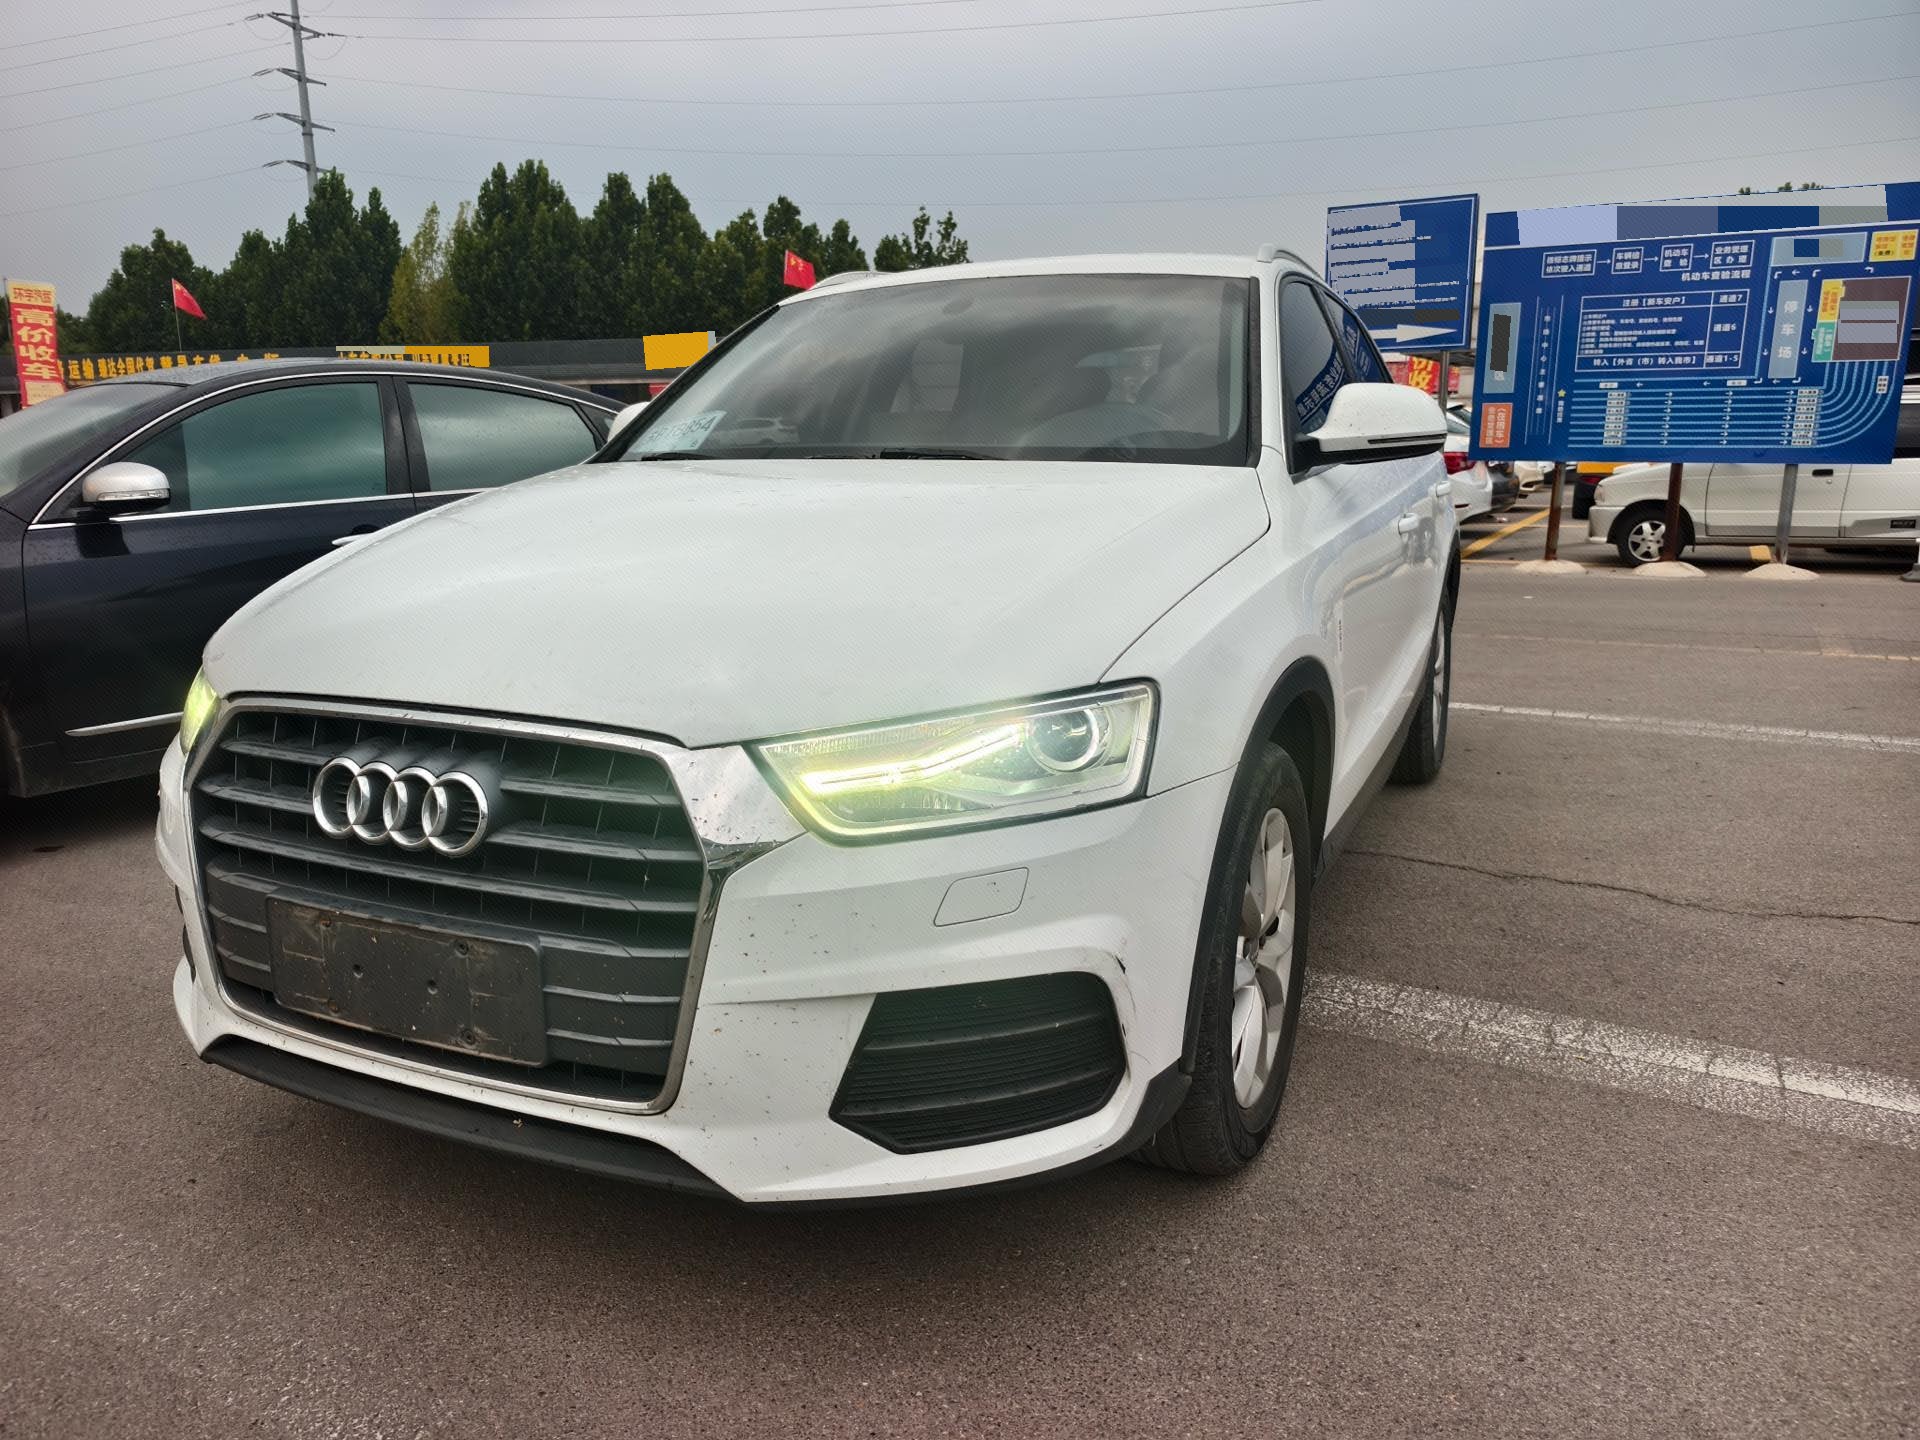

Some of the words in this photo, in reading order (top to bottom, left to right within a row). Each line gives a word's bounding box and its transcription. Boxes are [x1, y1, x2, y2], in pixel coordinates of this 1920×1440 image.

[1664, 248, 1689, 258] 机动车
[1681, 269, 1751, 282] 机动车查验流程
[14, 307, 58, 380] 高价收车
[1777, 300, 1799, 359] 停车场
